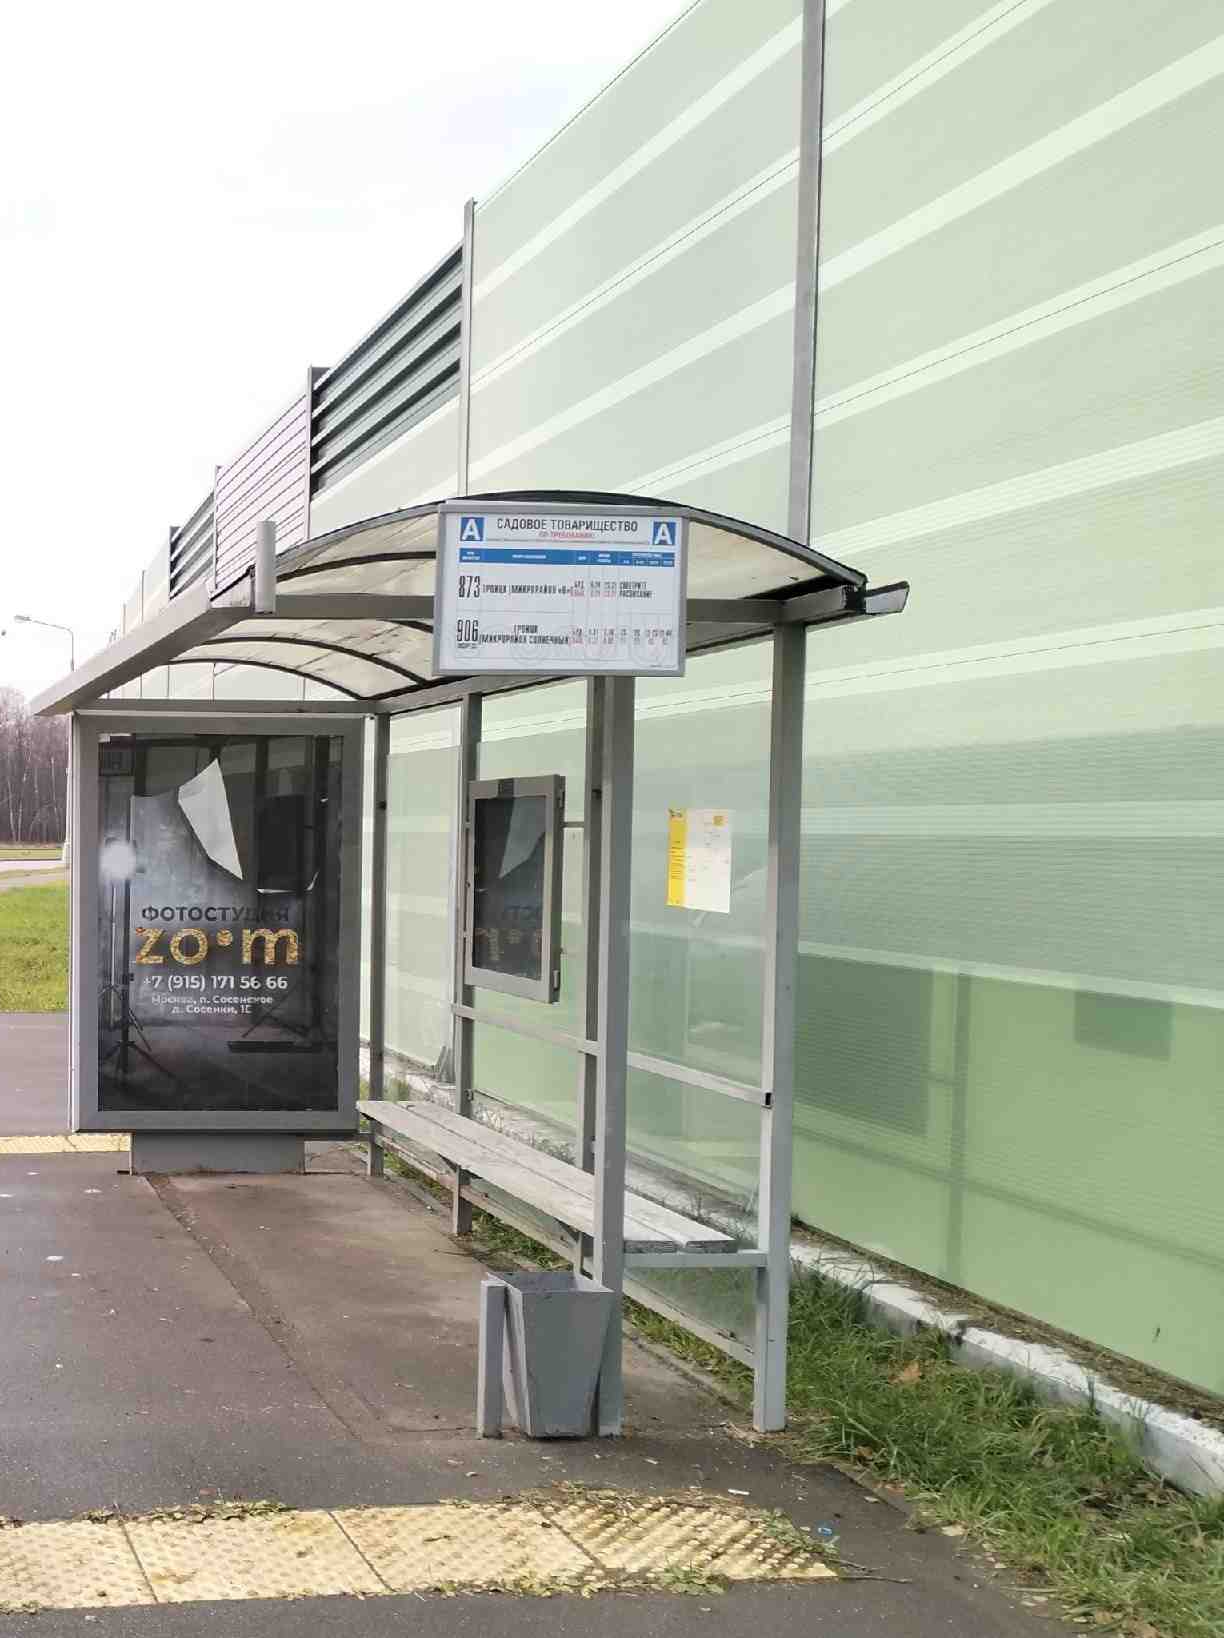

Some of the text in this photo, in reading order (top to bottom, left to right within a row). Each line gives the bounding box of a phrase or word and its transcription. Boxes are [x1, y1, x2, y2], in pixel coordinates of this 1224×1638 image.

[496, 518, 638, 533] САДОВОЕ ТОВАРИЩЕСТВО
[458, 575, 480, 598] 873
[456, 619, 479, 642] 906
[167, 975, 206, 992] (915)
[210, 975, 234, 989] 171
[240, 975, 261, 989] 56
[266, 975, 288, 989] 66
